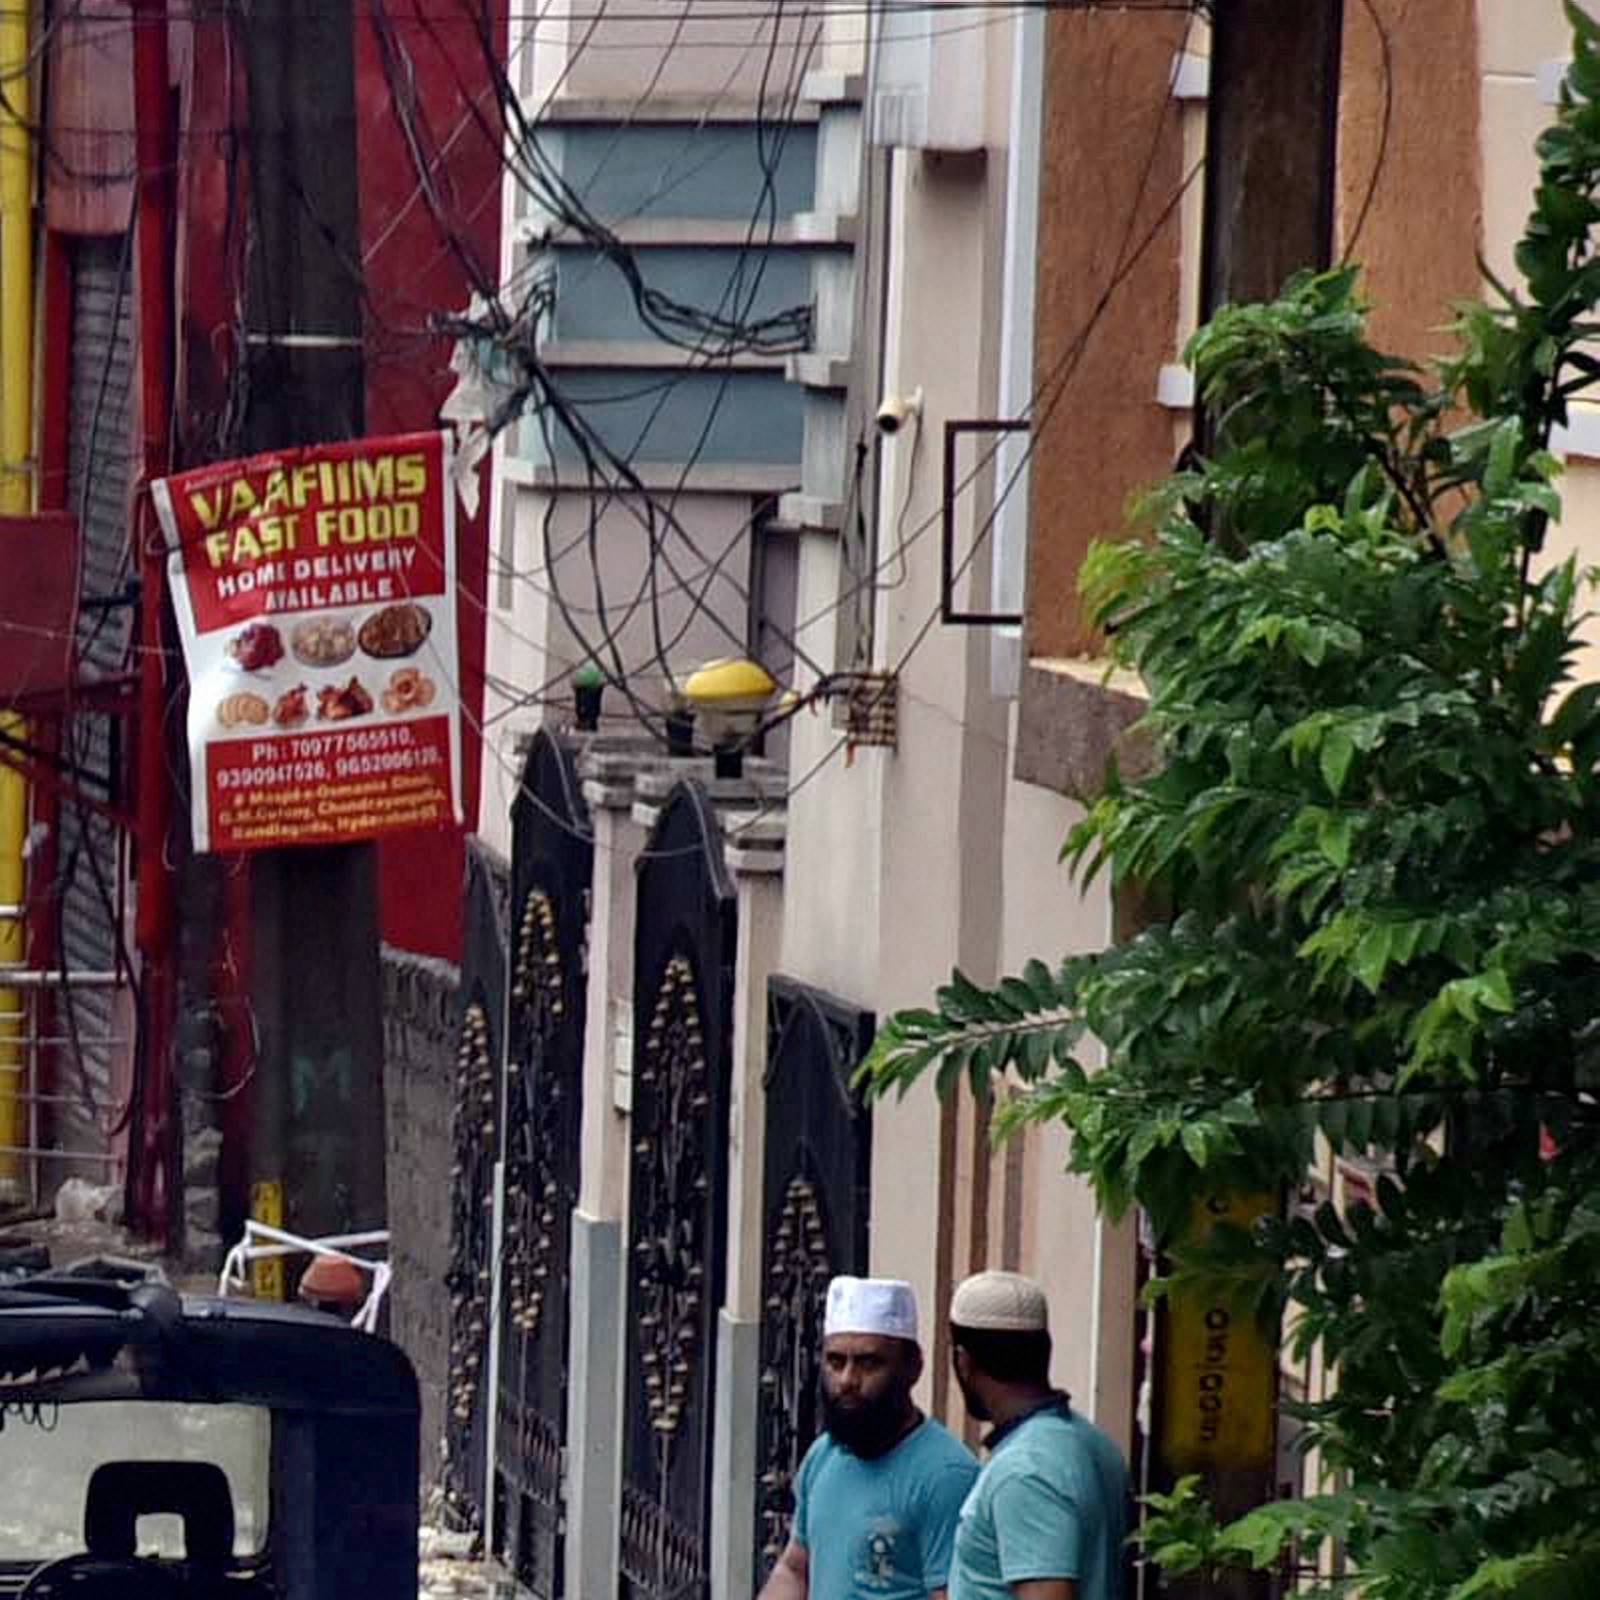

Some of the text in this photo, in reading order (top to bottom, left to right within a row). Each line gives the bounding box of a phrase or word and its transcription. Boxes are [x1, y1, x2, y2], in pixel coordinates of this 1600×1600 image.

[206, 502, 420, 568] FAST FOOD
[217, 547, 416, 598] HOME DELIVERY
[266, 577, 394, 611] AVAILABLE
